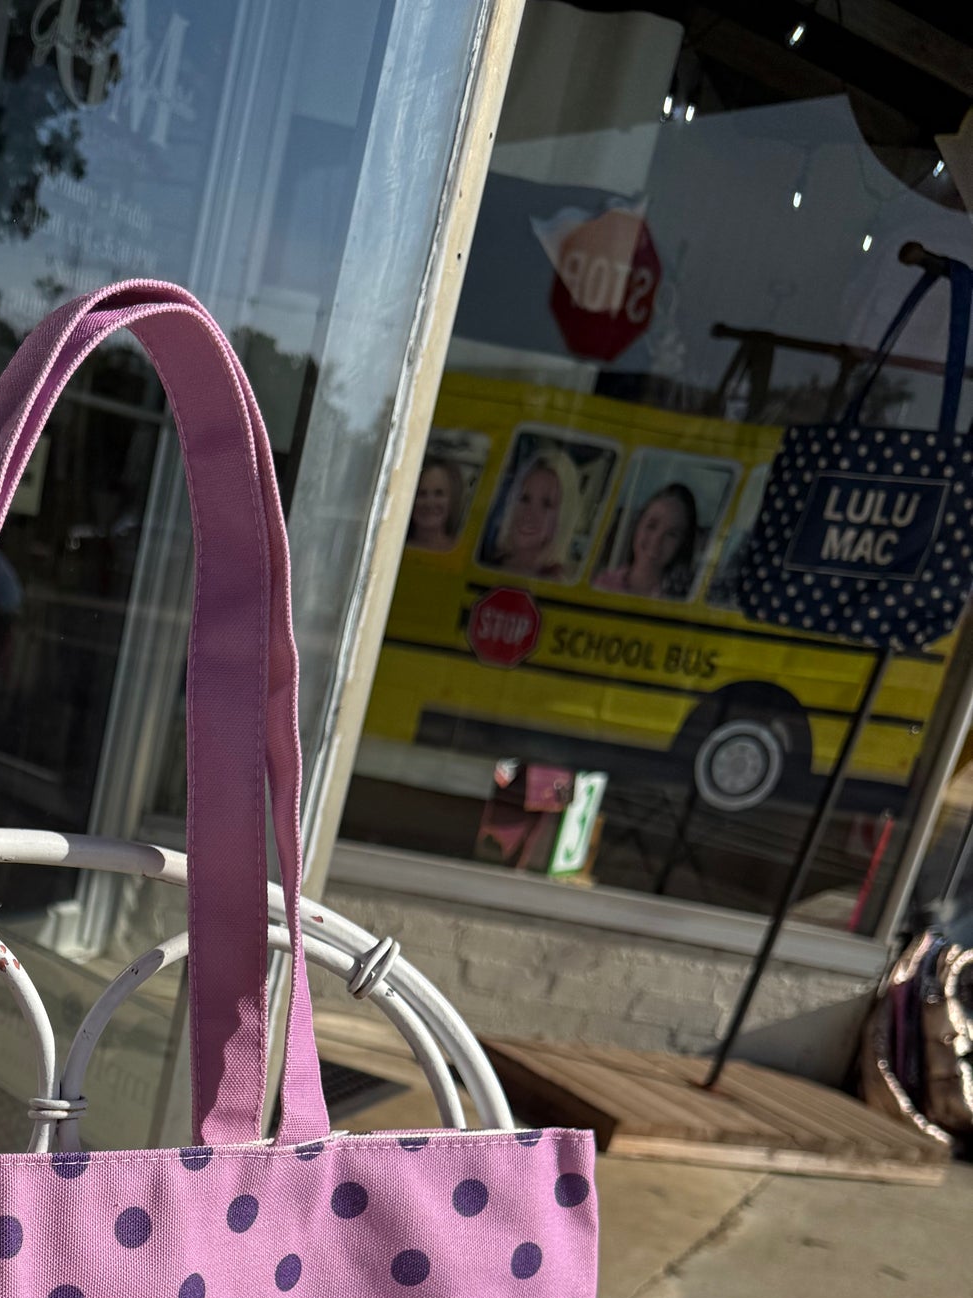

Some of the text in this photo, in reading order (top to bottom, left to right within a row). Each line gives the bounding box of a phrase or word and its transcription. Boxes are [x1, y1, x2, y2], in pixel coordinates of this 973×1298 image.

[823, 486, 919, 526] LULU
[821, 526, 899, 565] MAC
[479, 607, 530, 644] STOP
[551, 627, 719, 677] SCHOOL BUS
